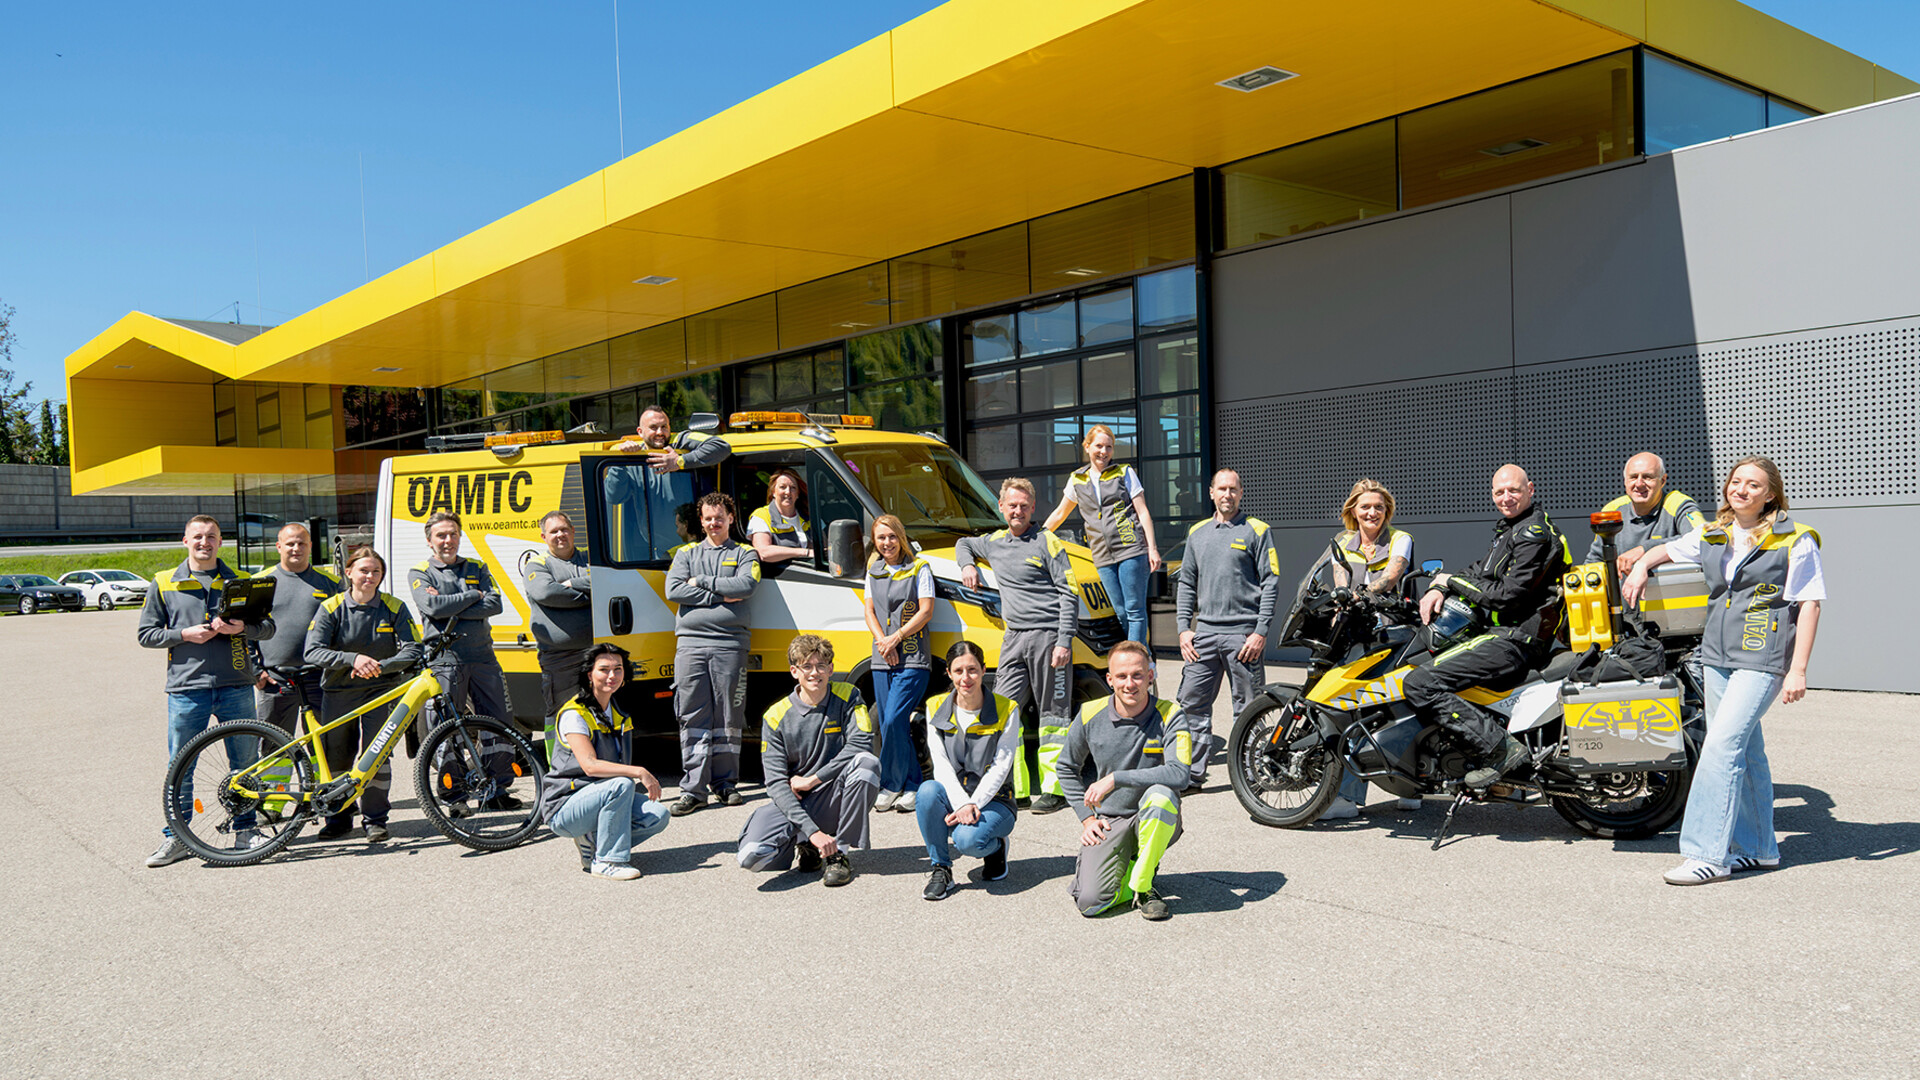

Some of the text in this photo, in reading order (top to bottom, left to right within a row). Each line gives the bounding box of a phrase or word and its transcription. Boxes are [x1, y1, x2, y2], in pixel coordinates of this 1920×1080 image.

[407, 470, 533, 518] ÖAMTC
[468, 519, 541, 531] www.oeamtc.at
[1080, 582, 1113, 610] ÖA
[1742, 583, 1779, 651] ÖAMTC
[1053, 665, 1065, 700] ÖAMT
[1329, 668, 1414, 710] ÖAMT
[1585, 741, 1604, 750] 120
